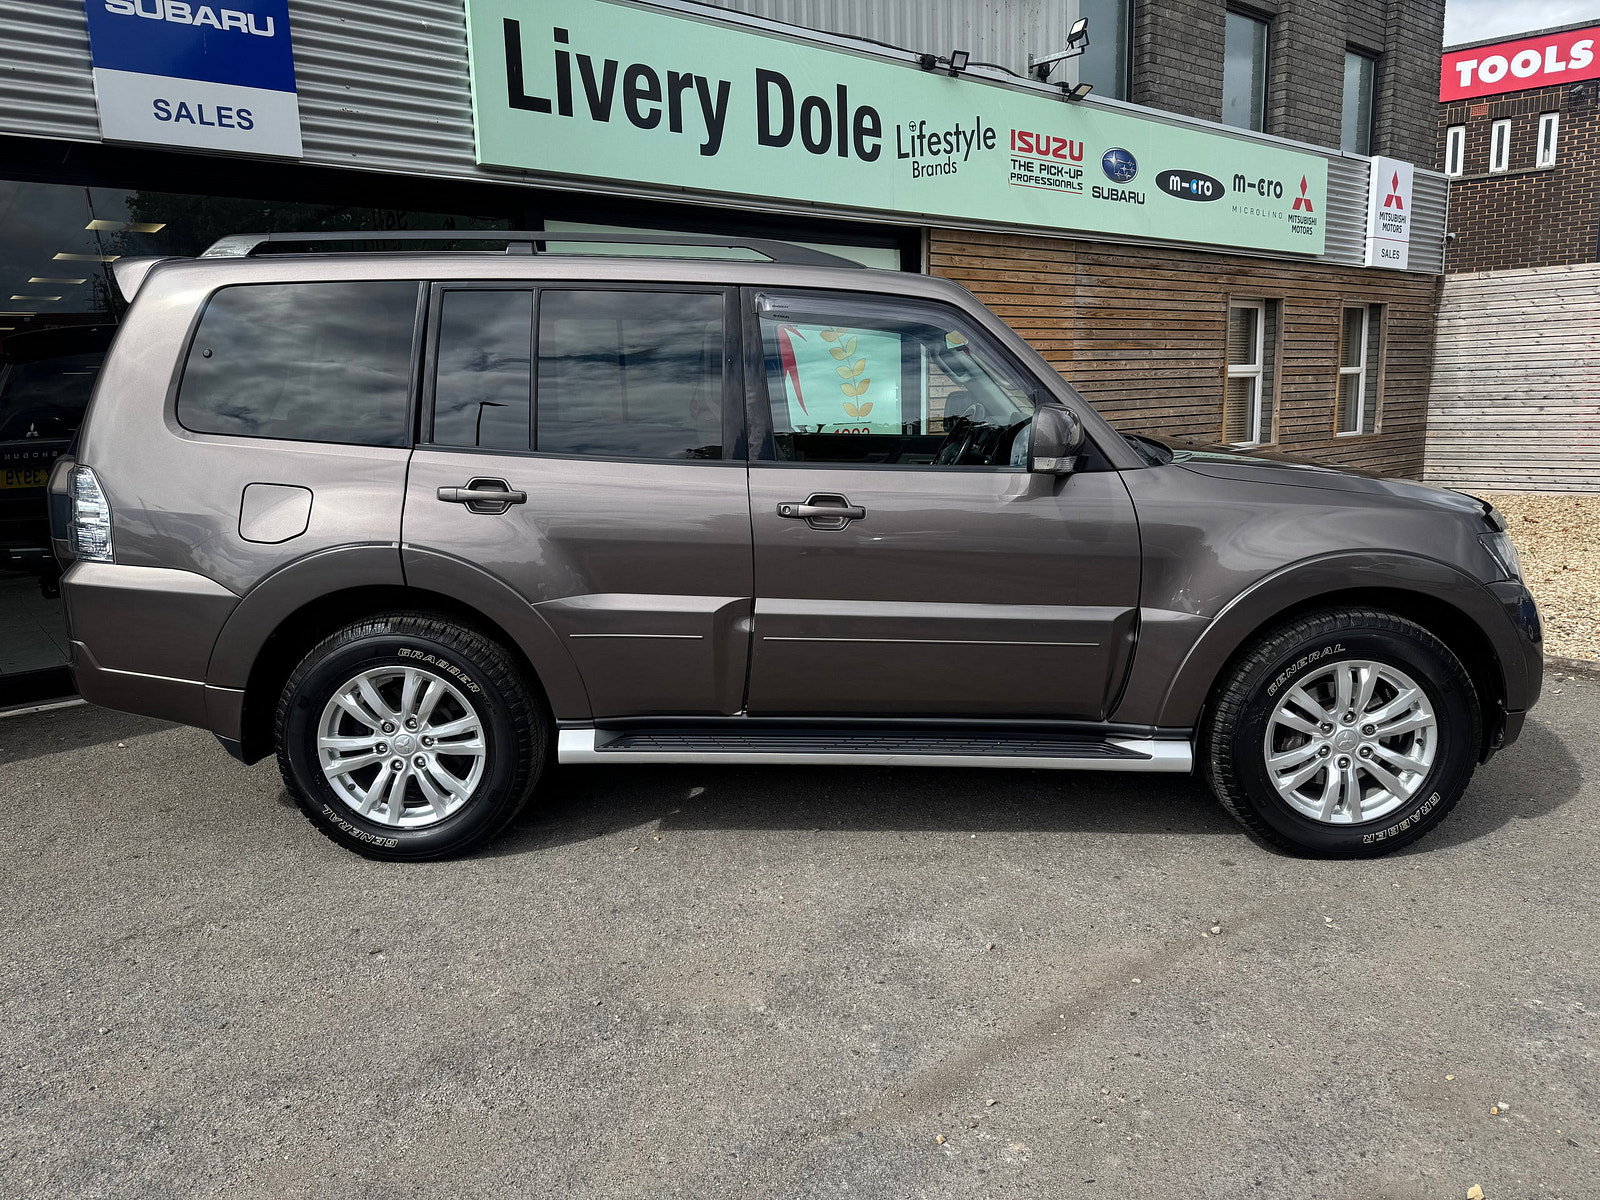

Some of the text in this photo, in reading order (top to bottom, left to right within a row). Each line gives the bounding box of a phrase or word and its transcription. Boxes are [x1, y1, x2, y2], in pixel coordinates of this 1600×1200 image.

[105, 0, 275, 37] SUBARU
[1455, 39, 1595, 88] TOOLS
[503, 17, 883, 163] Livery Dole
[152, 98, 255, 131] SALES
[896, 115, 996, 162] Lifestyle
[1010, 129, 1084, 162] ISUZU
[912, 156, 958, 178] Brands
[1010, 159, 1084, 180] THE PICK-UP
[1010, 172, 1084, 191] PROFESSIONALS
[1091, 185, 1146, 205] SUBARU
[1231, 205, 1284, 220] MICROLINO
[1287, 213, 1318, 226] MITSUBISHI
[1379, 211, 1407, 225] MITSUBISHI
[1291, 225, 1313, 236] MOTORS
[1381, 222, 1403, 234] MOTORS
[1380, 248, 1400, 260] SALES
[397, 648, 481, 693] GRABBER
[1267, 643, 1346, 697] GENERAL
[322, 803, 399, 848] GENERAL
[1362, 791, 1441, 844] GRABBER
